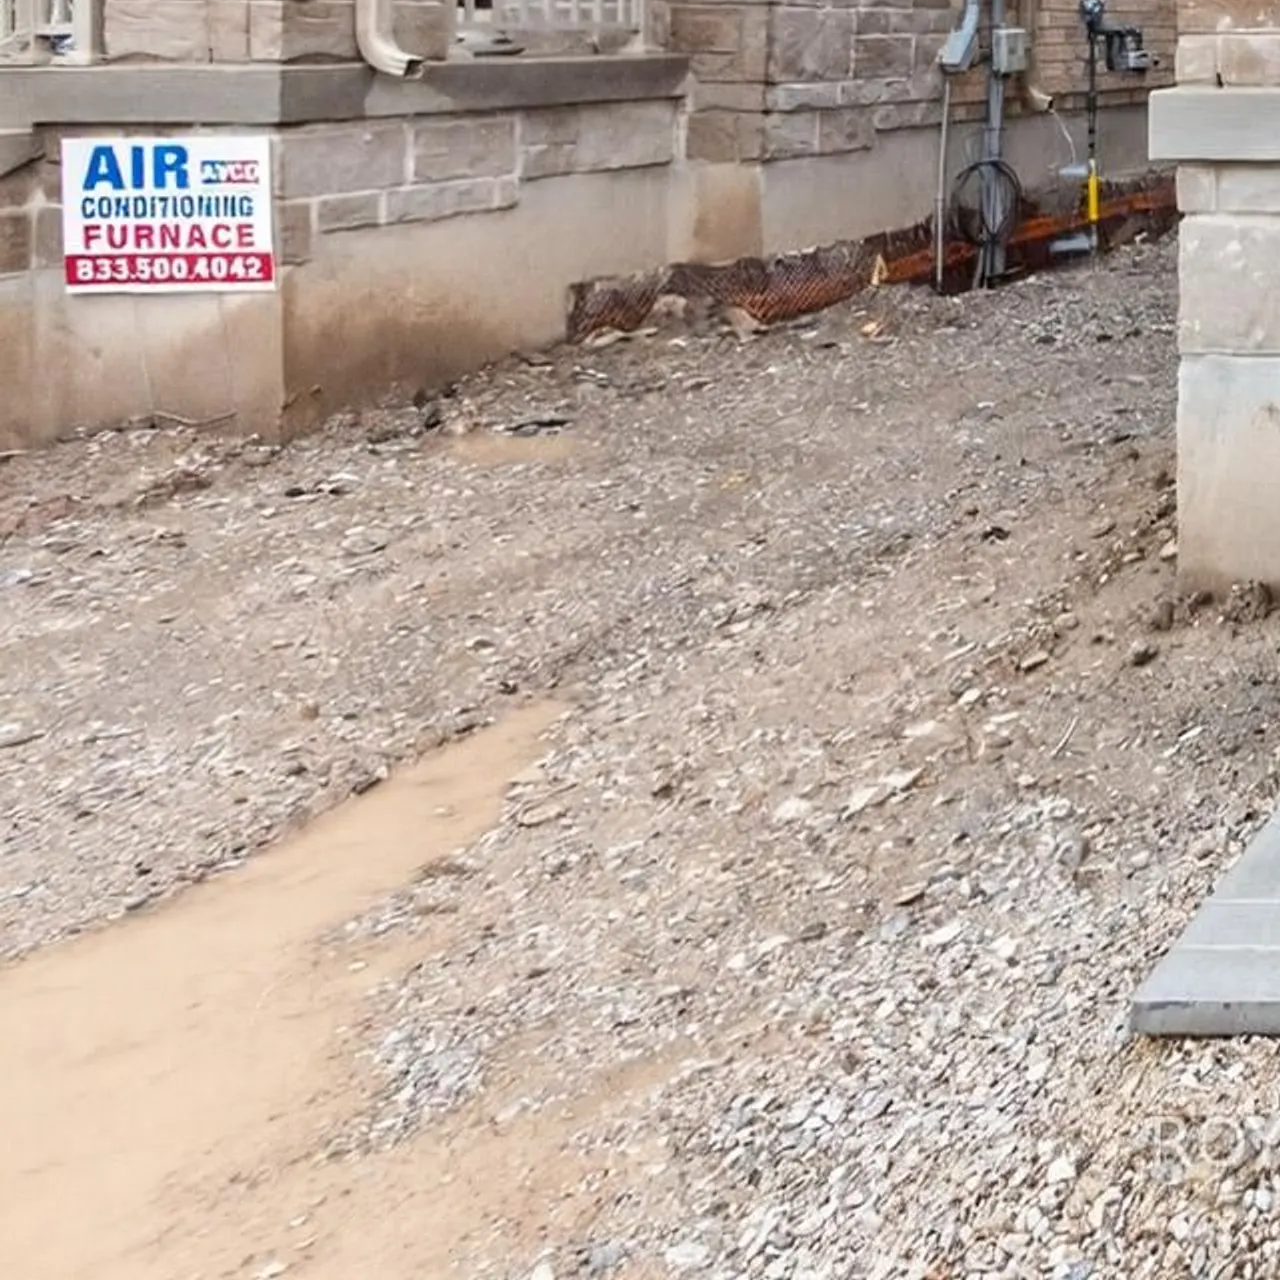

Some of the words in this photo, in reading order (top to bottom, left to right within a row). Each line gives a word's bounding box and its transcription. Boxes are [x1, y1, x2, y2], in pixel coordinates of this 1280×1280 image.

[82, 144, 190, 191] AIR
[81, 194, 254, 219] CONDITIONING
[83, 223, 256, 250] FURNACE
[75, 256, 263, 280] 833.500.4042
